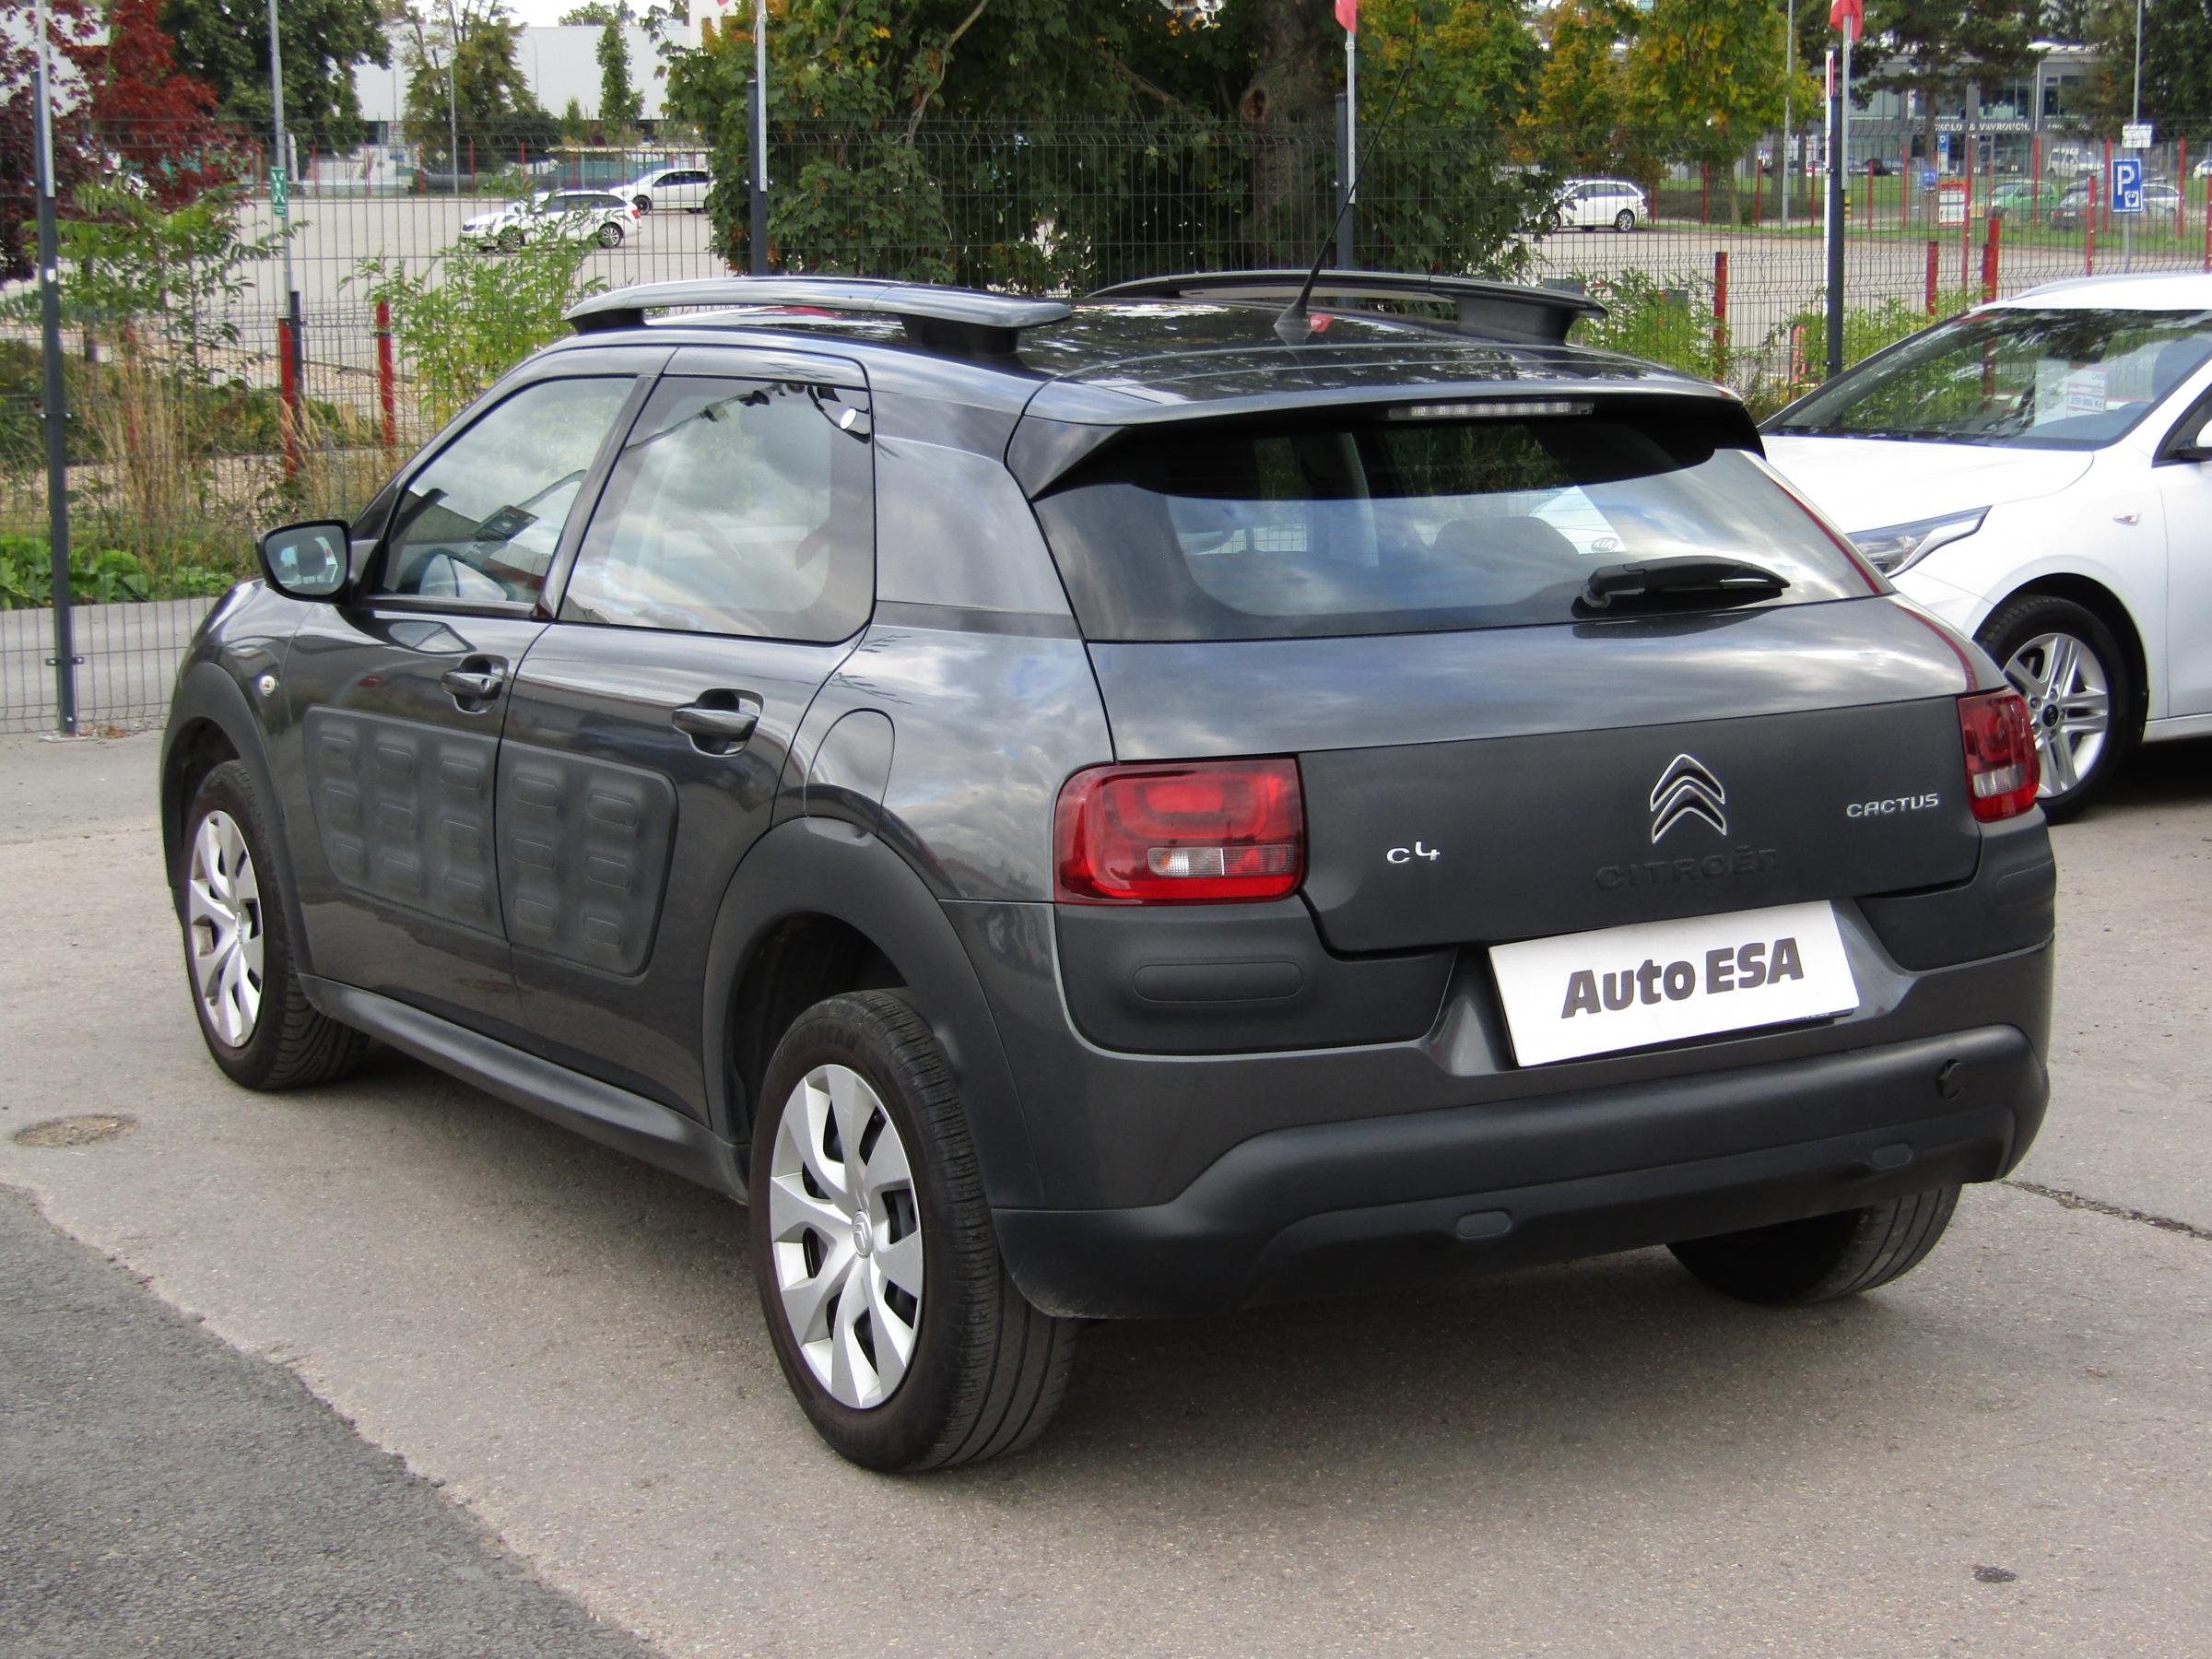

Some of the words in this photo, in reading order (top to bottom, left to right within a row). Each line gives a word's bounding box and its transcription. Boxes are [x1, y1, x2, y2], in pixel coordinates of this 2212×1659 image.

[2117, 165, 2135, 196] P
[1593, 538, 1616, 550] KIA
[1846, 793, 1939, 818] CACTUS
[1386, 841, 1441, 865] C4
[1561, 959, 1696, 1019] Auto
[1705, 936, 1804, 994] ESA
